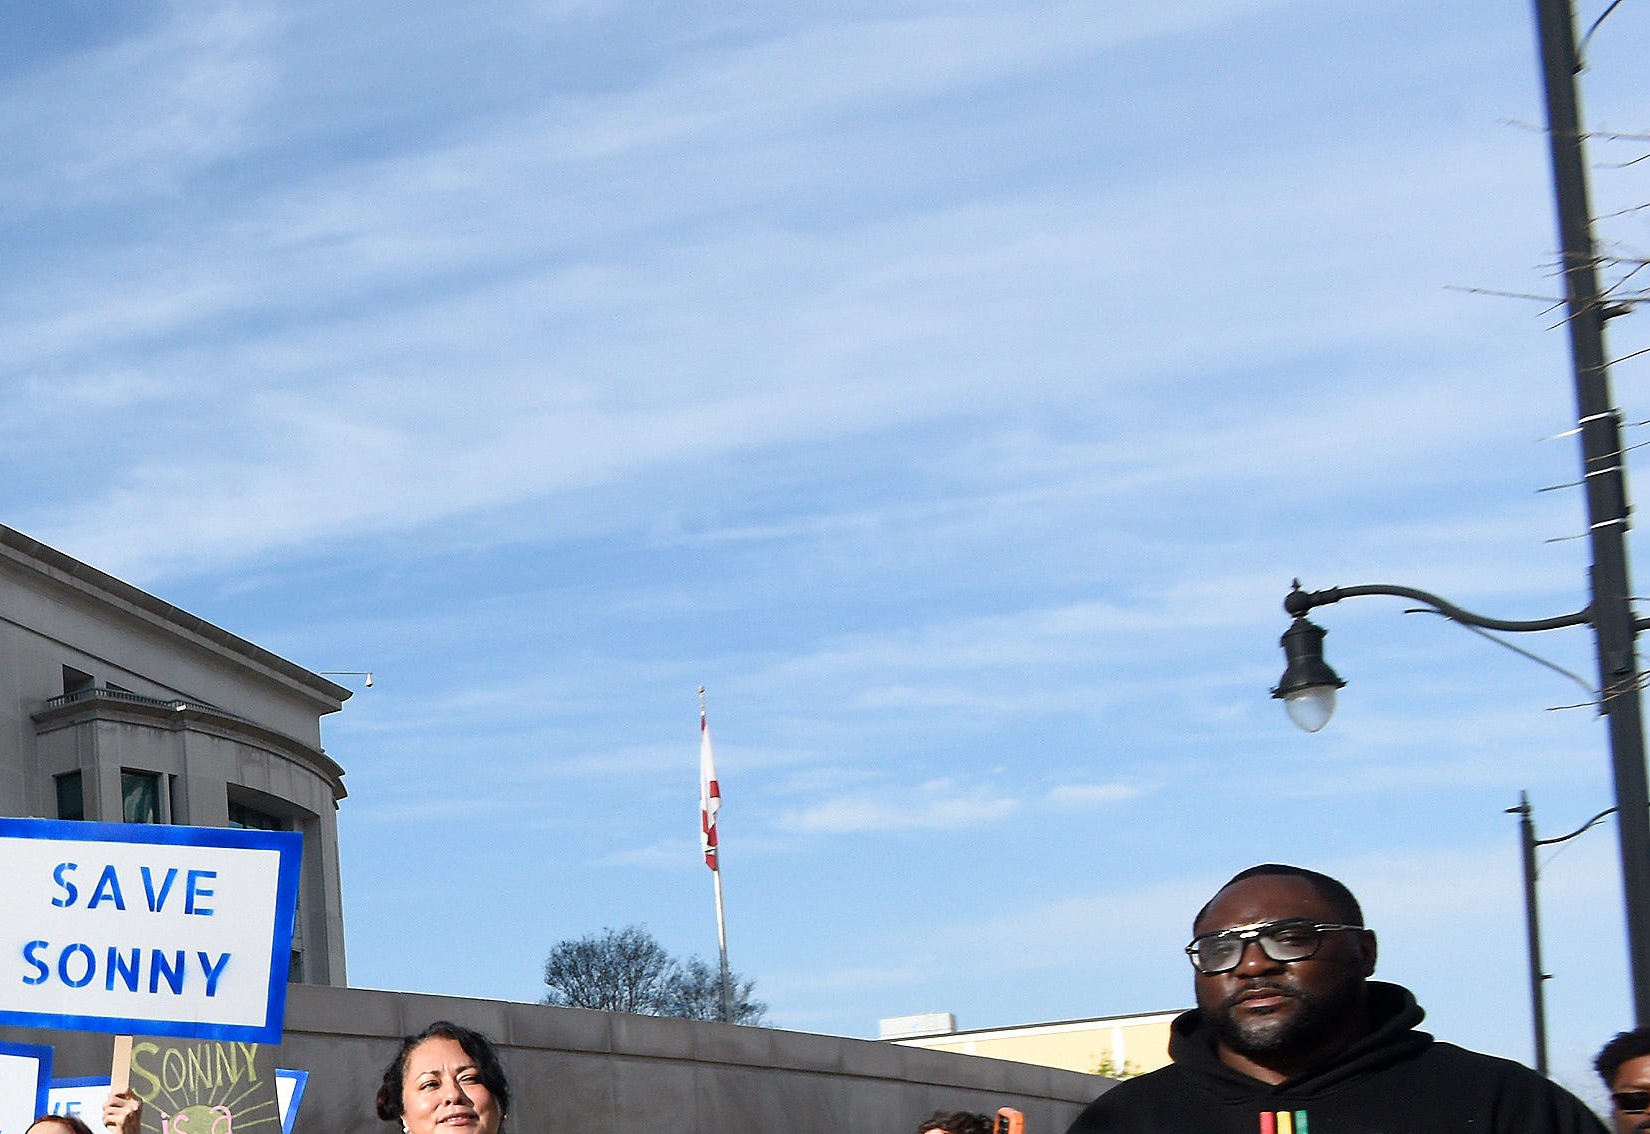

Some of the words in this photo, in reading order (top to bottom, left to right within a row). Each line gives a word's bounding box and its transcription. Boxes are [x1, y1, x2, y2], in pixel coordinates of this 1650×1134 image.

[51, 862, 218, 917] SAVE
[20, 938, 233, 998] SONNY
[130, 1042, 259, 1101] SONNY
